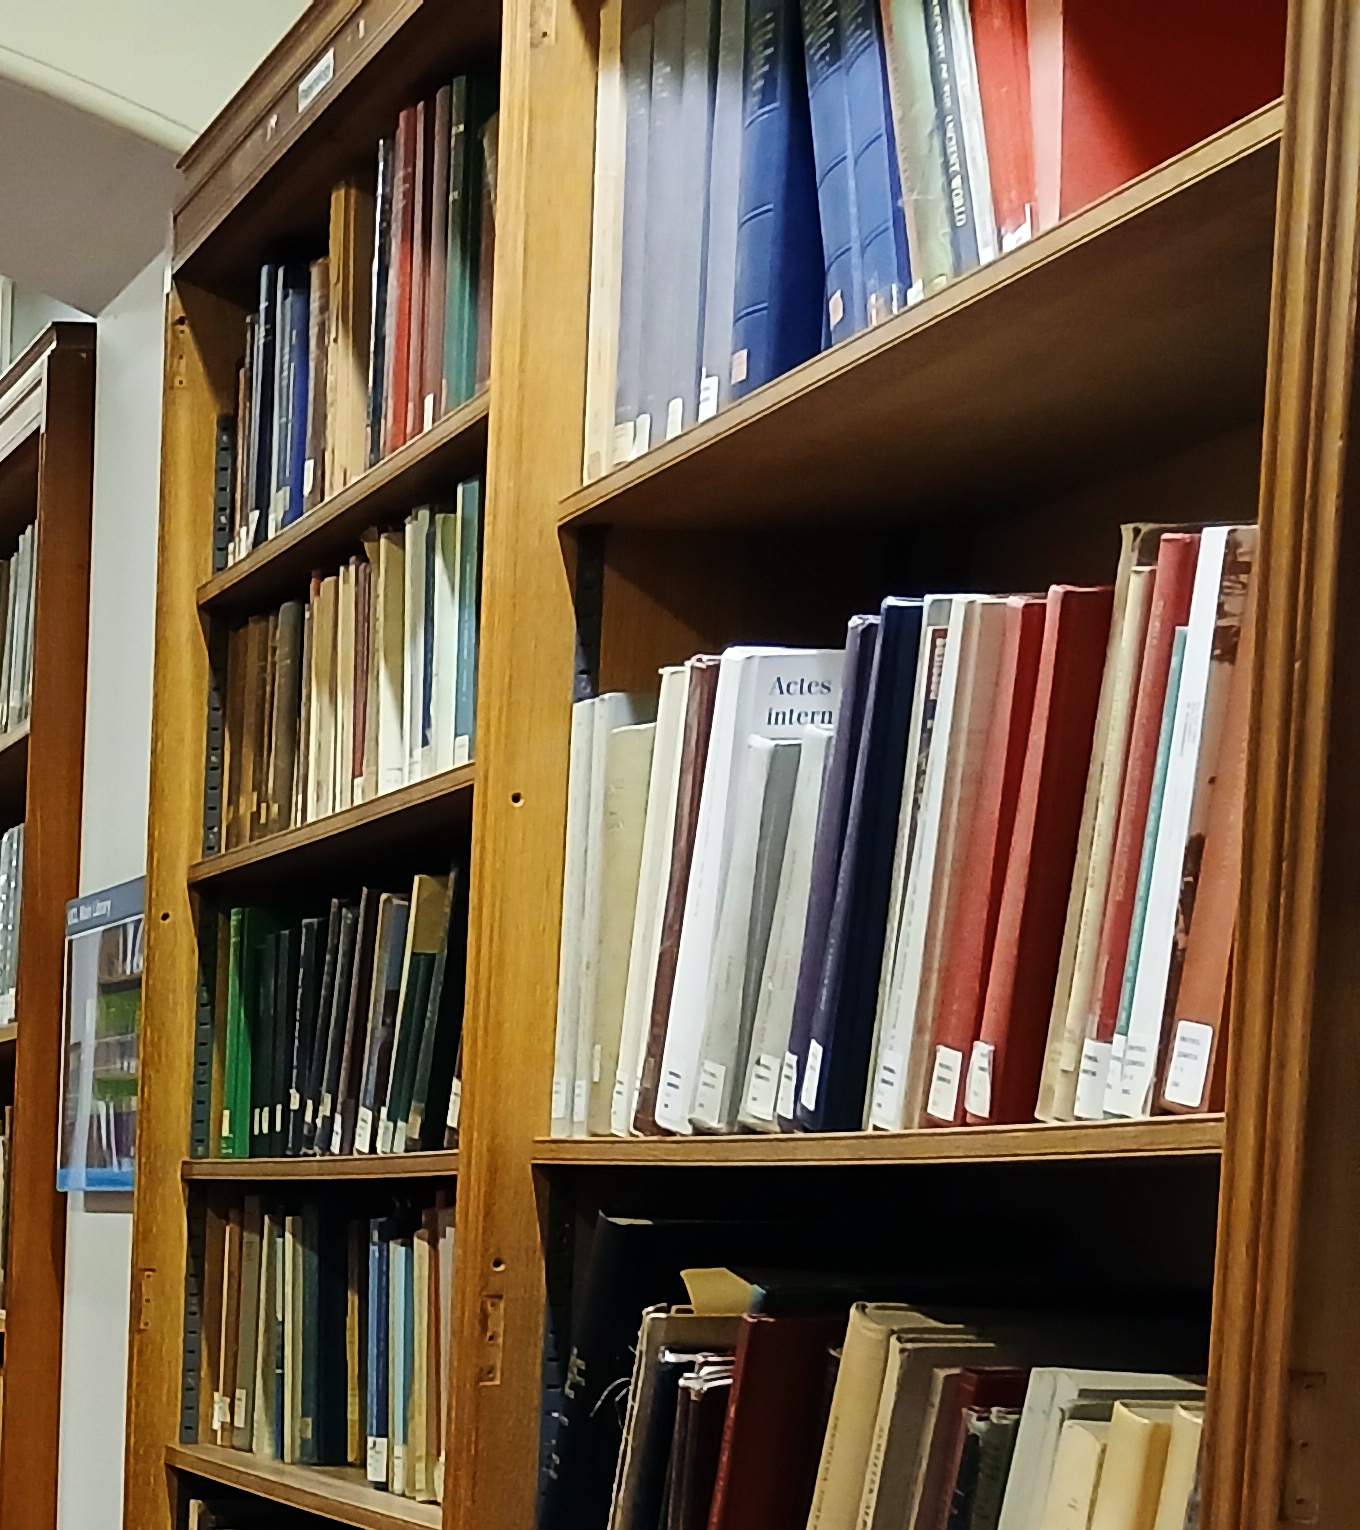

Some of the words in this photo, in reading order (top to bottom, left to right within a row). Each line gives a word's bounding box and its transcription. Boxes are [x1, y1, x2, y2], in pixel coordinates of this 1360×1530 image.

[950, 175, 967, 227] WORLD
[769, 676, 832, 696] Actes
[766, 707, 833, 726] intern
